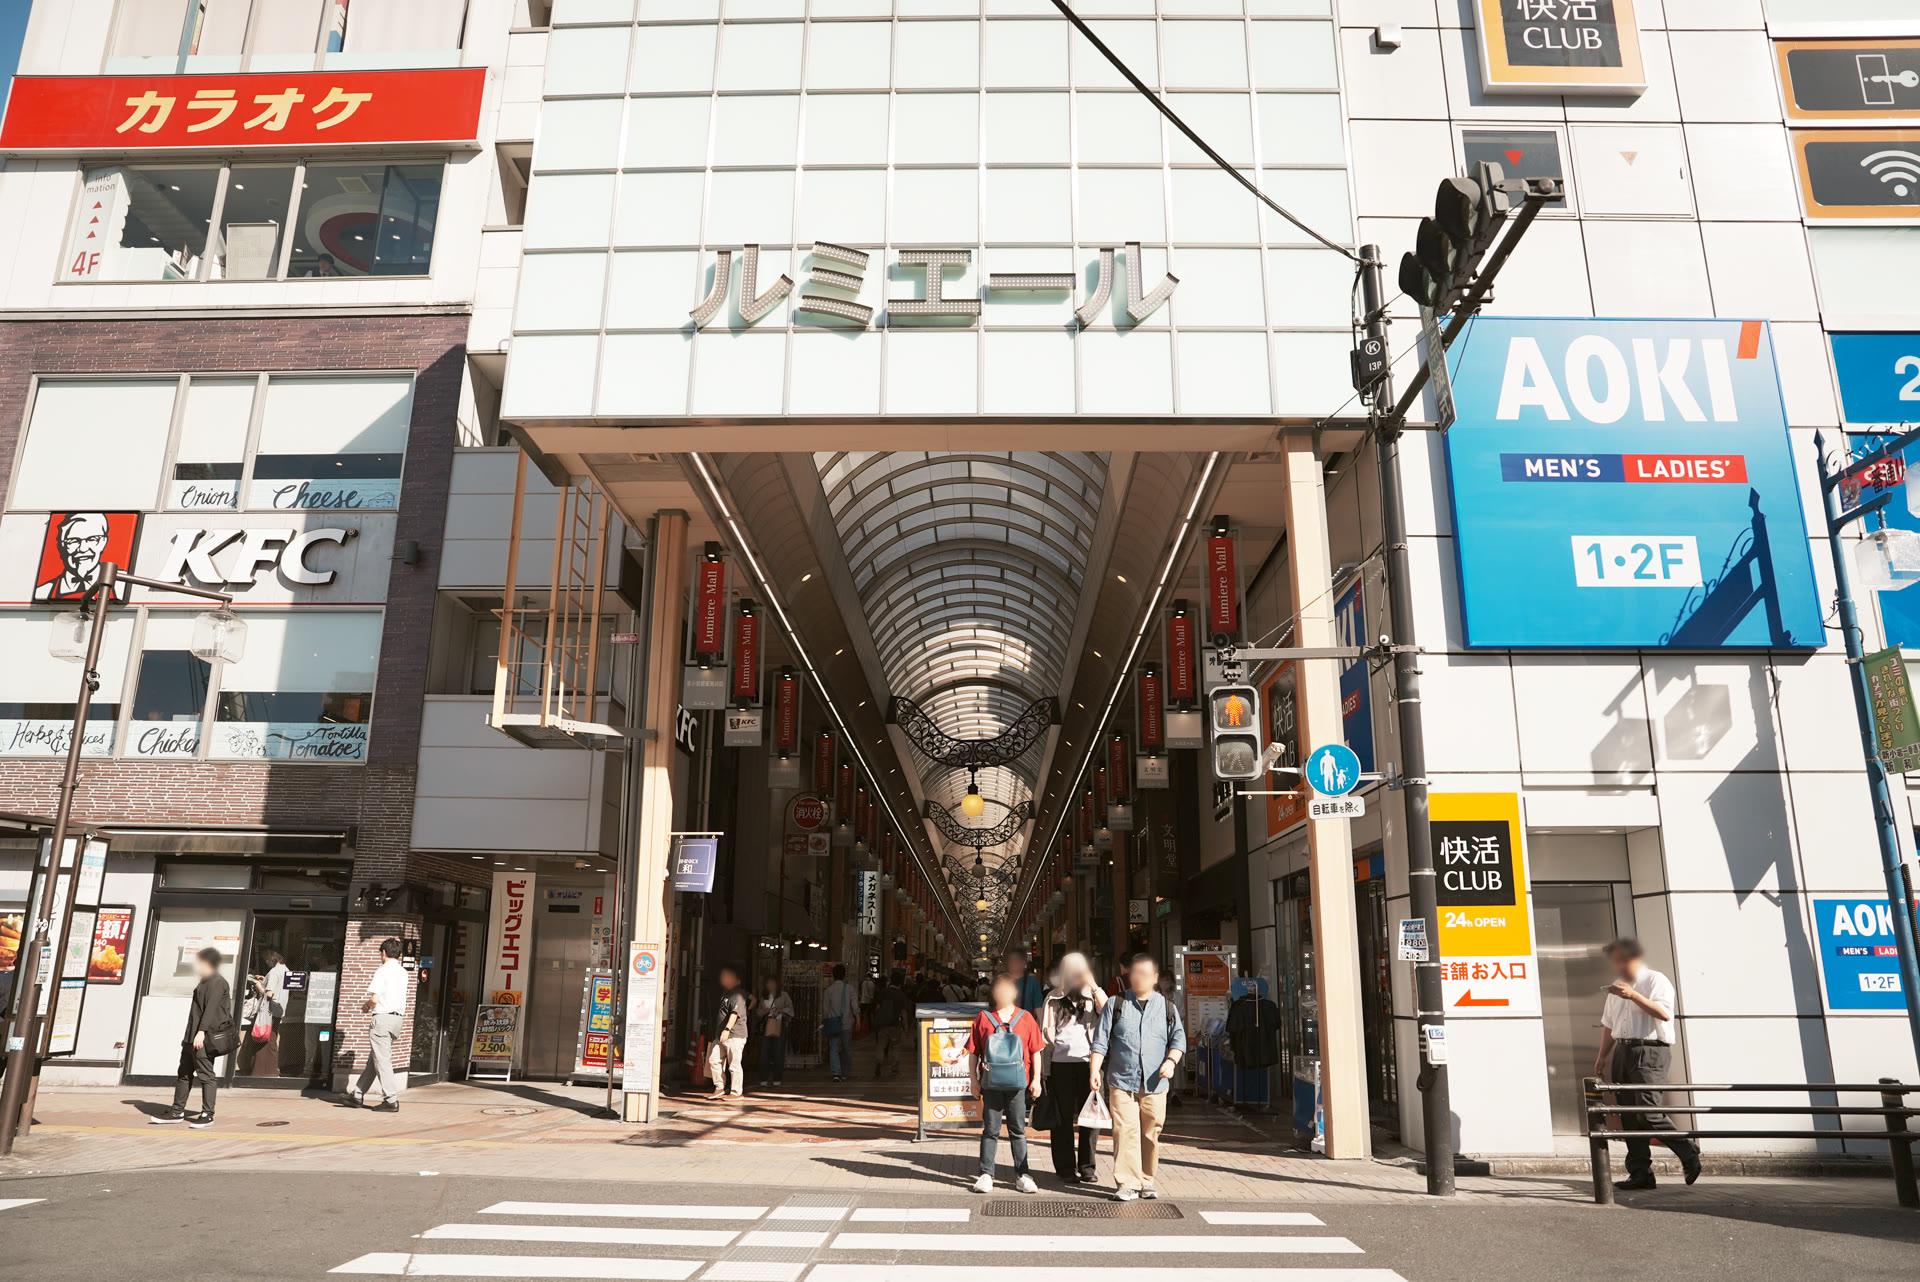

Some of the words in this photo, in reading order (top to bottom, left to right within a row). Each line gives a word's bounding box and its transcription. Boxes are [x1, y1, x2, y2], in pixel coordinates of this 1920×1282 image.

[1522, 27, 1603, 49] CLUB
[116, 87, 373, 133] カラオケ
[86, 184, 115, 193] mation
[71, 251, 100, 276] 4F
[689, 241, 1180, 328] ルミエール
[1369, 361, 1382, 371] 13P
[1496, 335, 1738, 424] AOKI
[1524, 458, 1601, 477] MEN'S
[1637, 459, 1731, 478] LADIES'
[180, 485, 238, 508] Onions
[272, 481, 363, 508] Cheese
[157, 528, 348, 585] KFC
[1215, 546, 1228, 572] Mall
[706, 570, 718, 594] Mall
[1217, 576, 1230, 625] Lumiere
[703, 599, 716, 644] Lumiere
[742, 624, 752, 645] Mall
[1175, 625, 1185, 646] Mall
[740, 649, 751, 689] Lumiere
[1177, 650, 1187, 691] Lumiere
[783, 685, 792, 704] Mall
[1146, 683, 1155, 702] Mall
[1342, 694, 1358, 716] ADIES'
[781, 705, 791, 741] Lumiere
[1147, 703, 1157, 739] Lumiere
[1273, 691, 1294, 741] 快活
[1871, 675, 1893, 748] カメラが見ています
[9, 721, 53, 750] Herbs
[316, 726, 368, 740] Tortilla
[276, 735, 363, 759] Tomatoes
[795, 806, 822, 820] 消火栓
[1313, 801, 1359, 815] 自転車を除く
[1440, 836, 1500, 865] 快活
[1443, 870, 1503, 891] CLUB
[867, 875, 877, 931] メガネスーパー
[1474, 917, 1506, 927] OPEN
[1832, 904, 1895, 937] AOK
[500, 880, 527, 990] ビッグエコー
[1842, 947, 1868, 955] MEN'S
[597, 987, 610, 1001] 学
